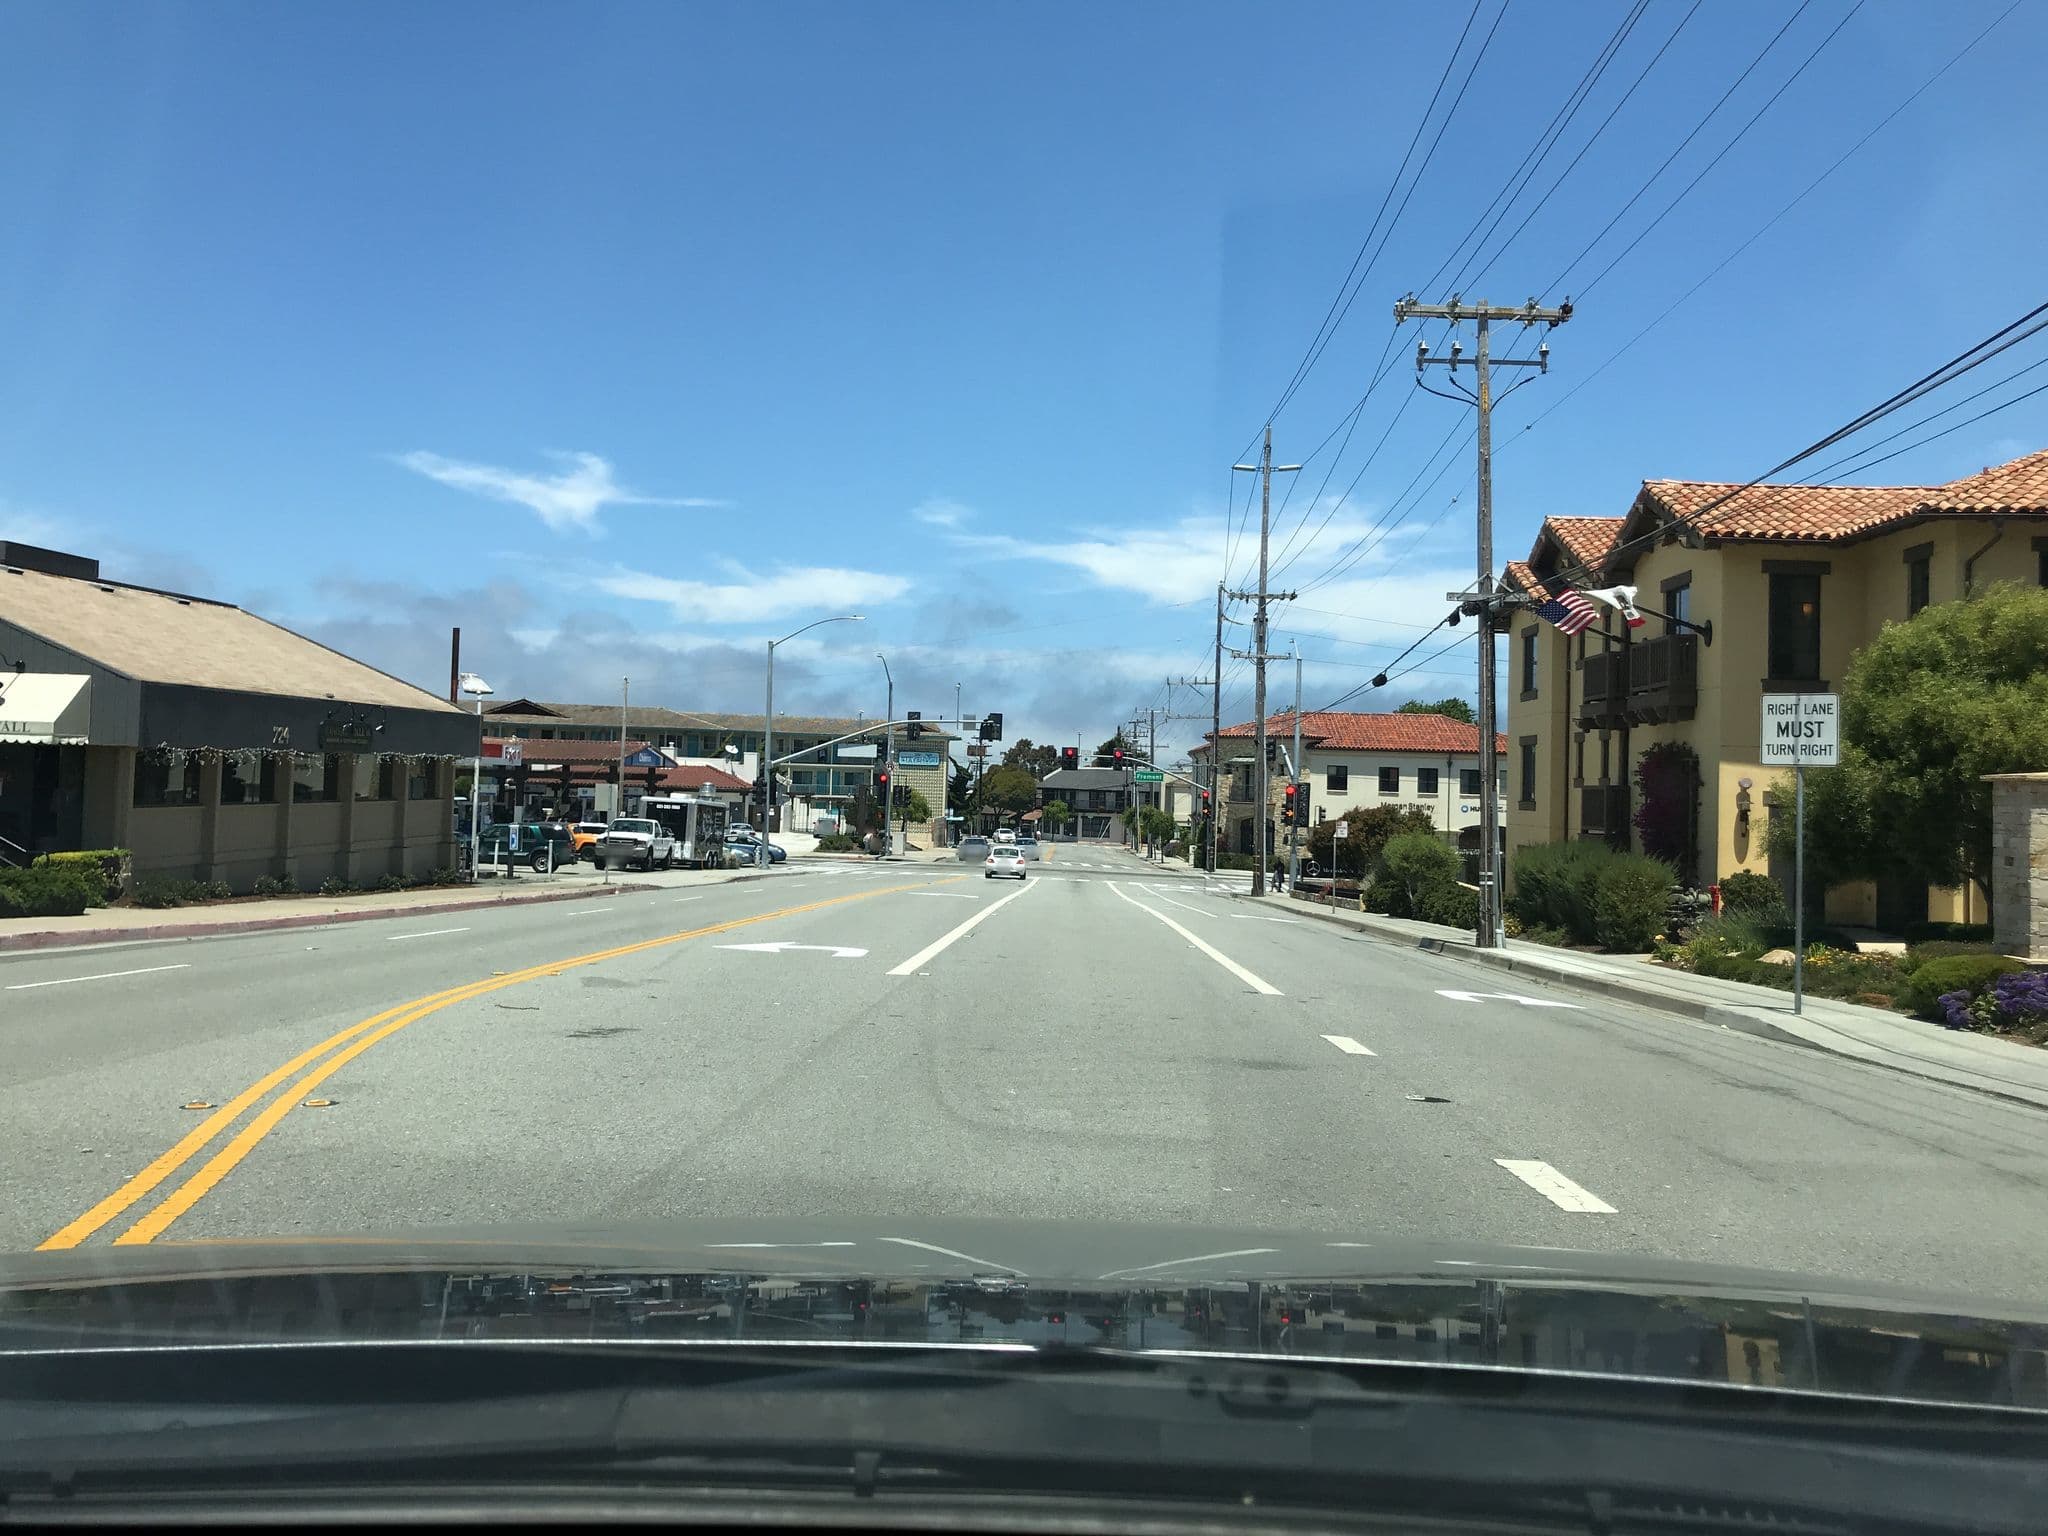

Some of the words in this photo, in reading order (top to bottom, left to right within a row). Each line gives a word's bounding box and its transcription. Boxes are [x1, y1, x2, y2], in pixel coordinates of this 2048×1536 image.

[1768, 704, 1799, 715] RIGHT
[1804, 704, 1833, 715] LANE
[1777, 721, 1824, 738] MUST
[1766, 744, 1795, 756] TURN
[1800, 745, 1833, 756] RIGHT
[1408, 803, 1435, 813] Stanley
